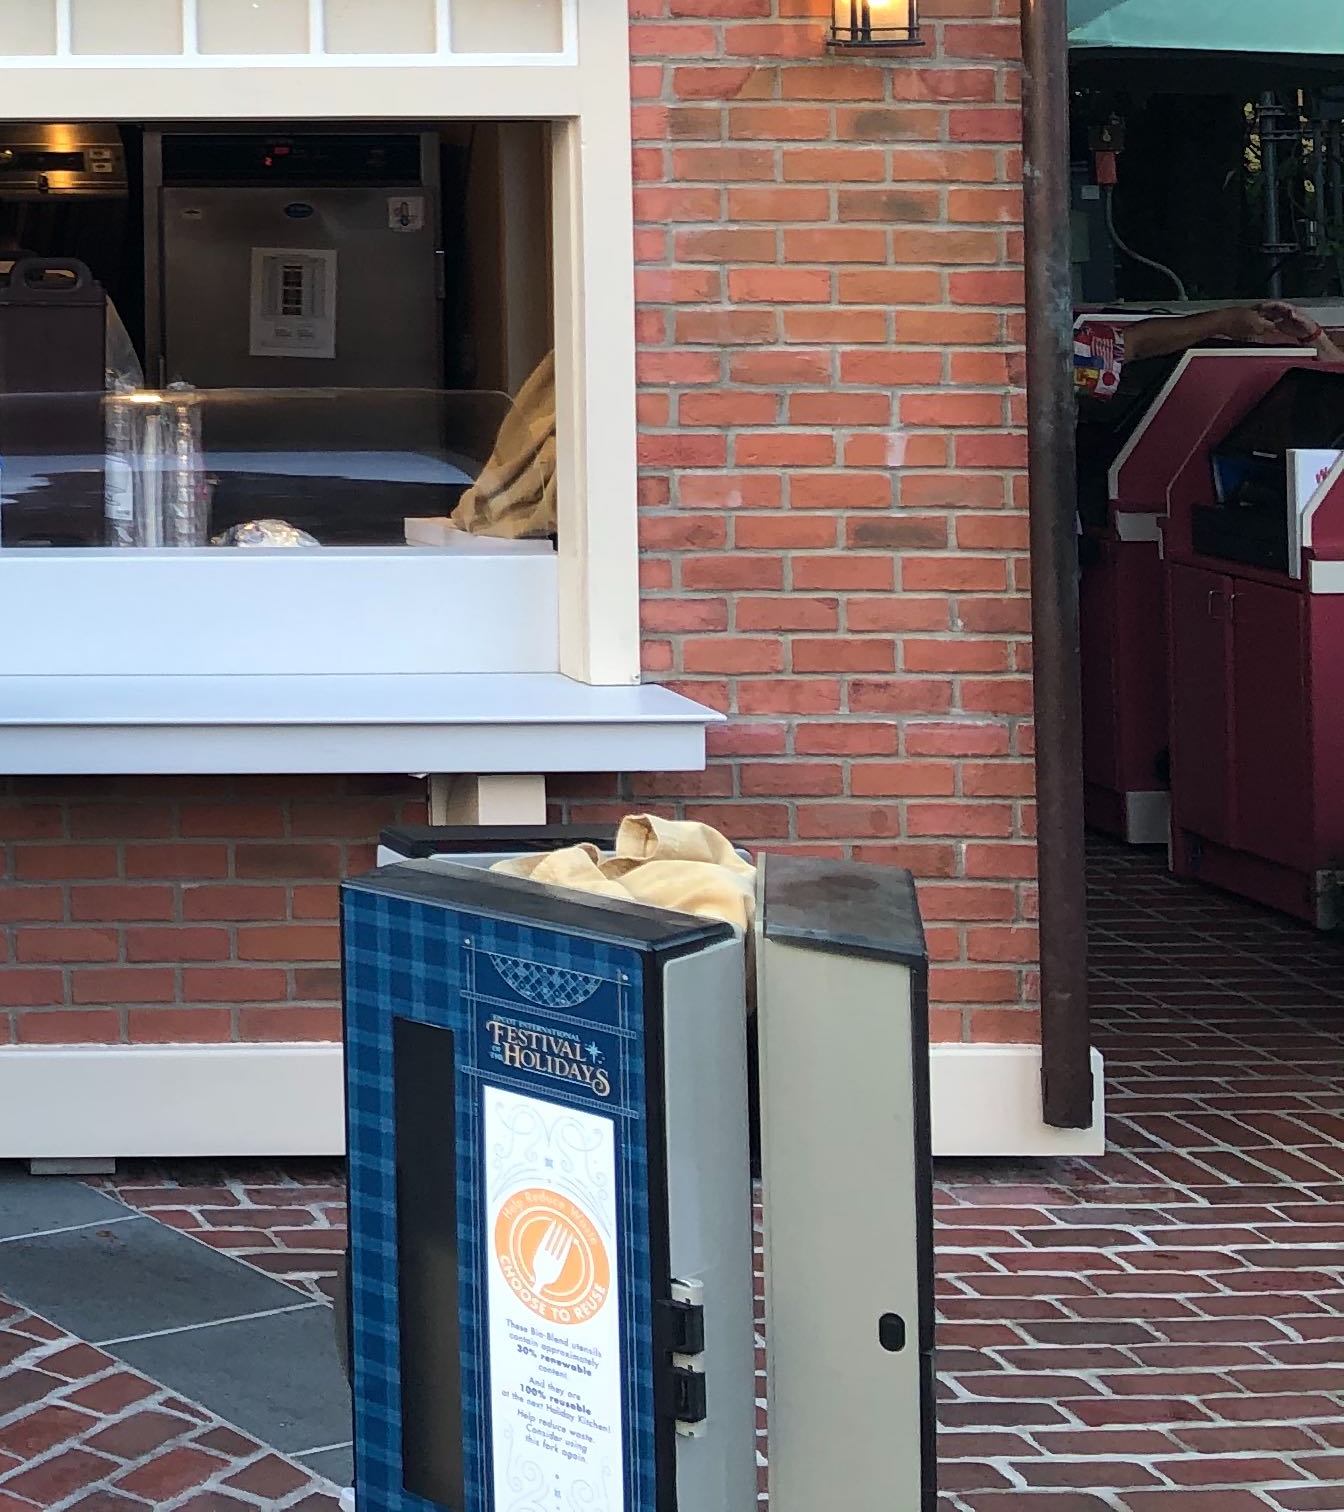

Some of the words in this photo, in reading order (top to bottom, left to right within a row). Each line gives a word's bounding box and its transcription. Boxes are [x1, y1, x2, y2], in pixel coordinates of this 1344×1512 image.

[486, 1020, 587, 1062] FESTIVAL
[502, 1041, 611, 1097] HOLIDAYS
[499, 1255, 547, 1315] CHOOSE
[551, 1306, 571, 1321] TO
[574, 1282, 606, 1320] REUSE
[506, 1318, 528, 1333] These
[509, 1332, 538, 1347] contain
[541, 1343, 599, 1369] approximately
[540, 1354, 592, 1376] renewable
[520, 1383, 547, 1400] 100%
[549, 1395, 592, 1416] reusable
[529, 1377, 545, 1388] And
[548, 1381, 564, 1396] they
[568, 1390, 581, 1400] are
[517, 1408, 536, 1422] Help
[538, 1418, 567, 1433] reduce
[546, 1404, 575, 1422] Holiday
[525, 1423, 563, 1442] Consider
[565, 1439, 588, 1454] using
[525, 1434, 540, 1447] this
[542, 1439, 559, 1453] fork
